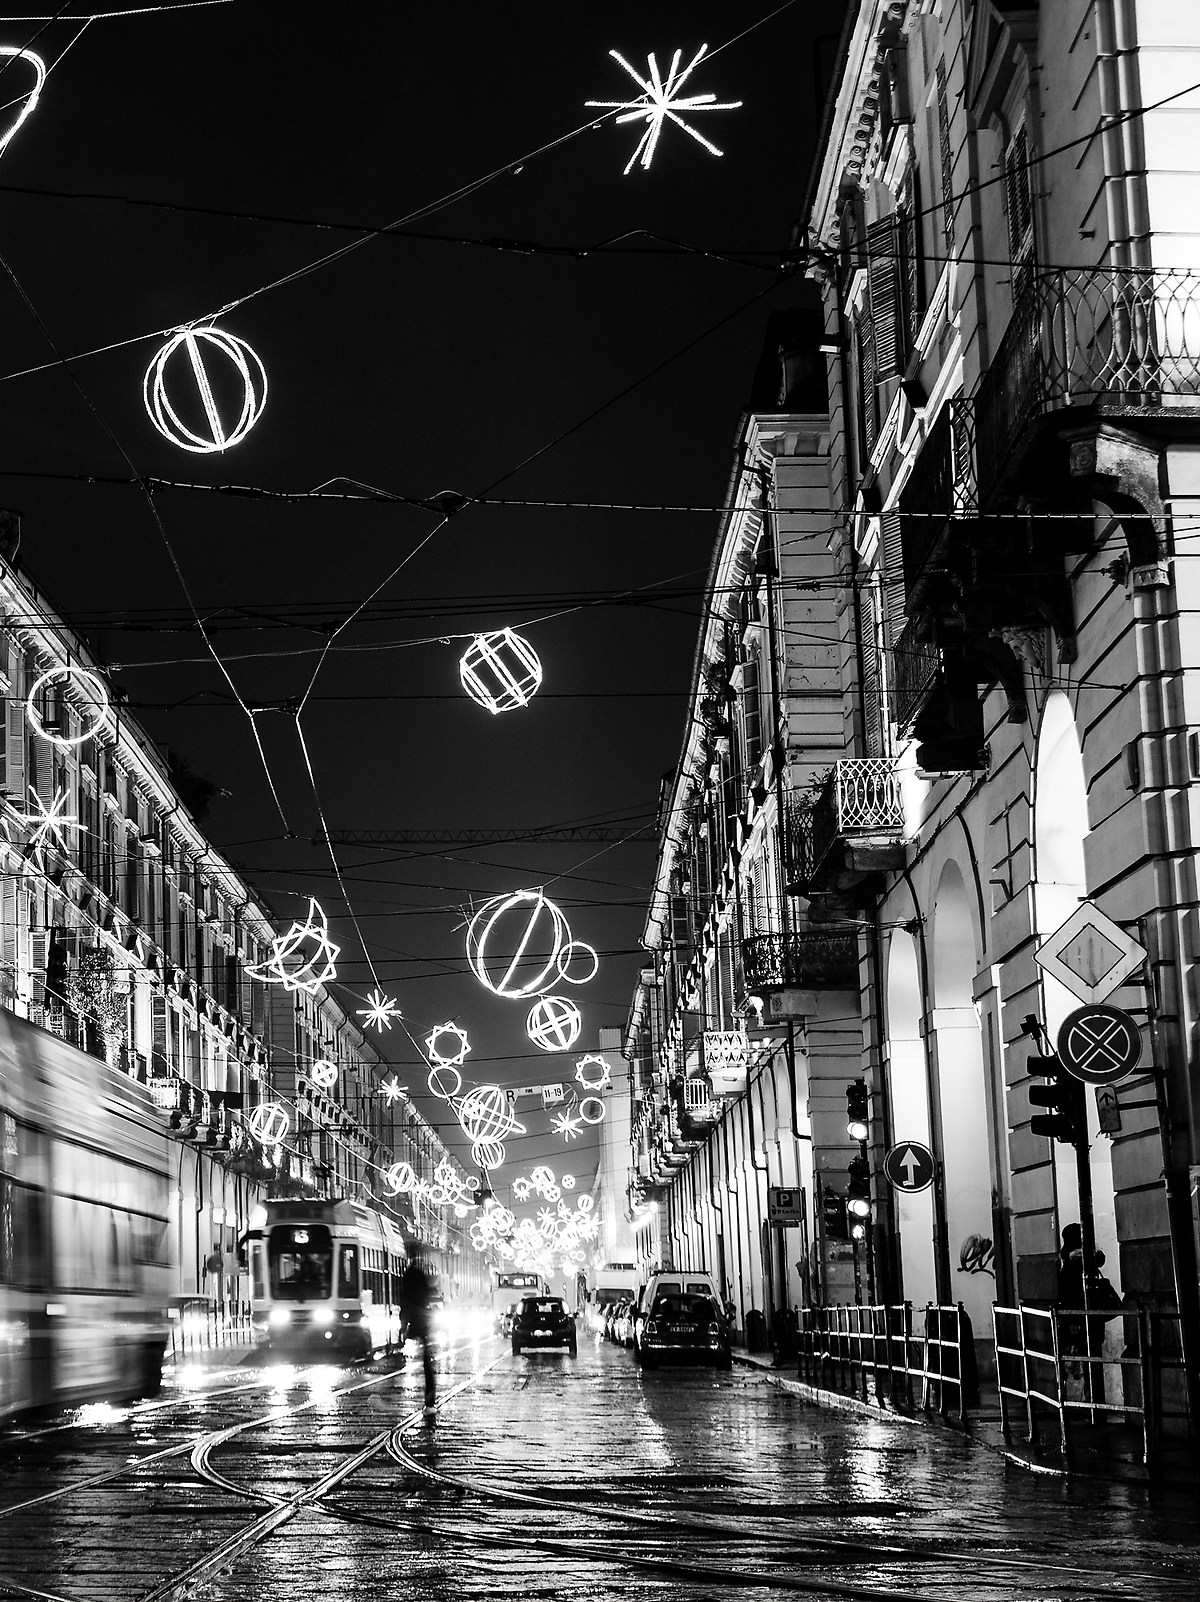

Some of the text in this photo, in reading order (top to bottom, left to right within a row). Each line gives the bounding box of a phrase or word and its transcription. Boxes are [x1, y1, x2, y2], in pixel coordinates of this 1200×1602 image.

[506, 1090, 515, 1102] R
[544, 1088, 562, 1098] 11-19
[780, 1193, 789, 1205] P
